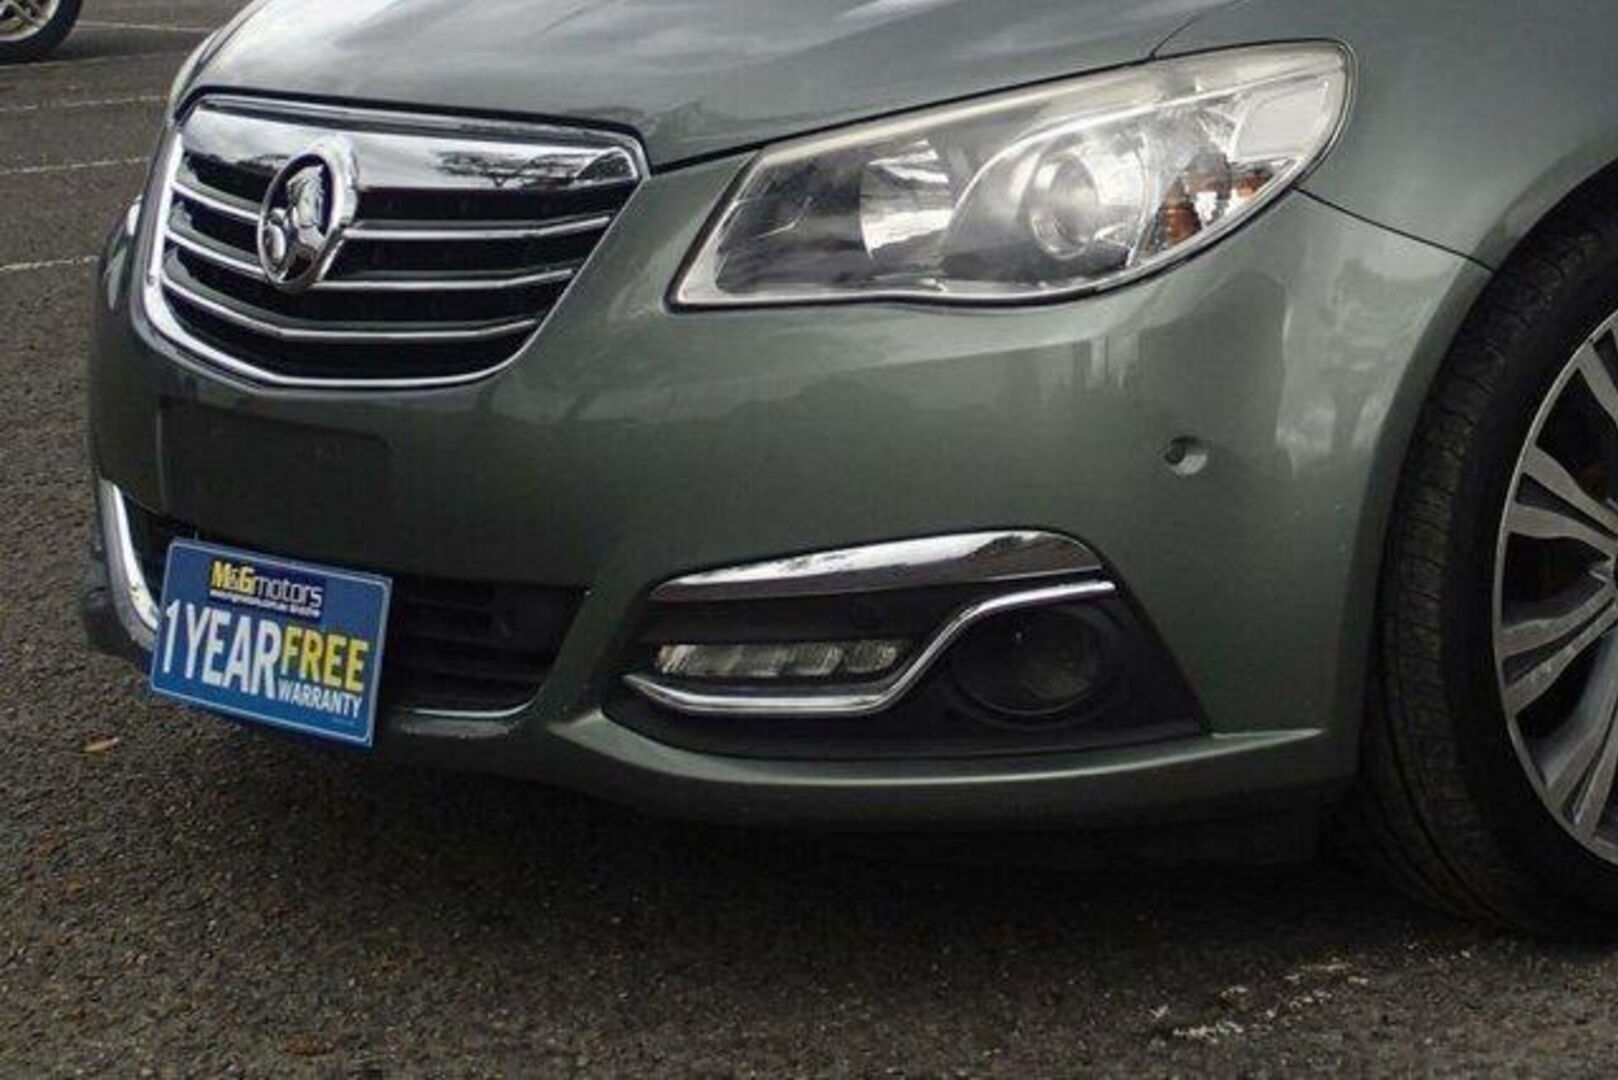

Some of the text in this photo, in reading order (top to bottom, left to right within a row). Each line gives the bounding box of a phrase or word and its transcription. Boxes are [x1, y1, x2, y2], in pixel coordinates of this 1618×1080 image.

[163, 598, 369, 700] 1 YEAR FREE
[277, 678, 363, 719] WARRANTY
